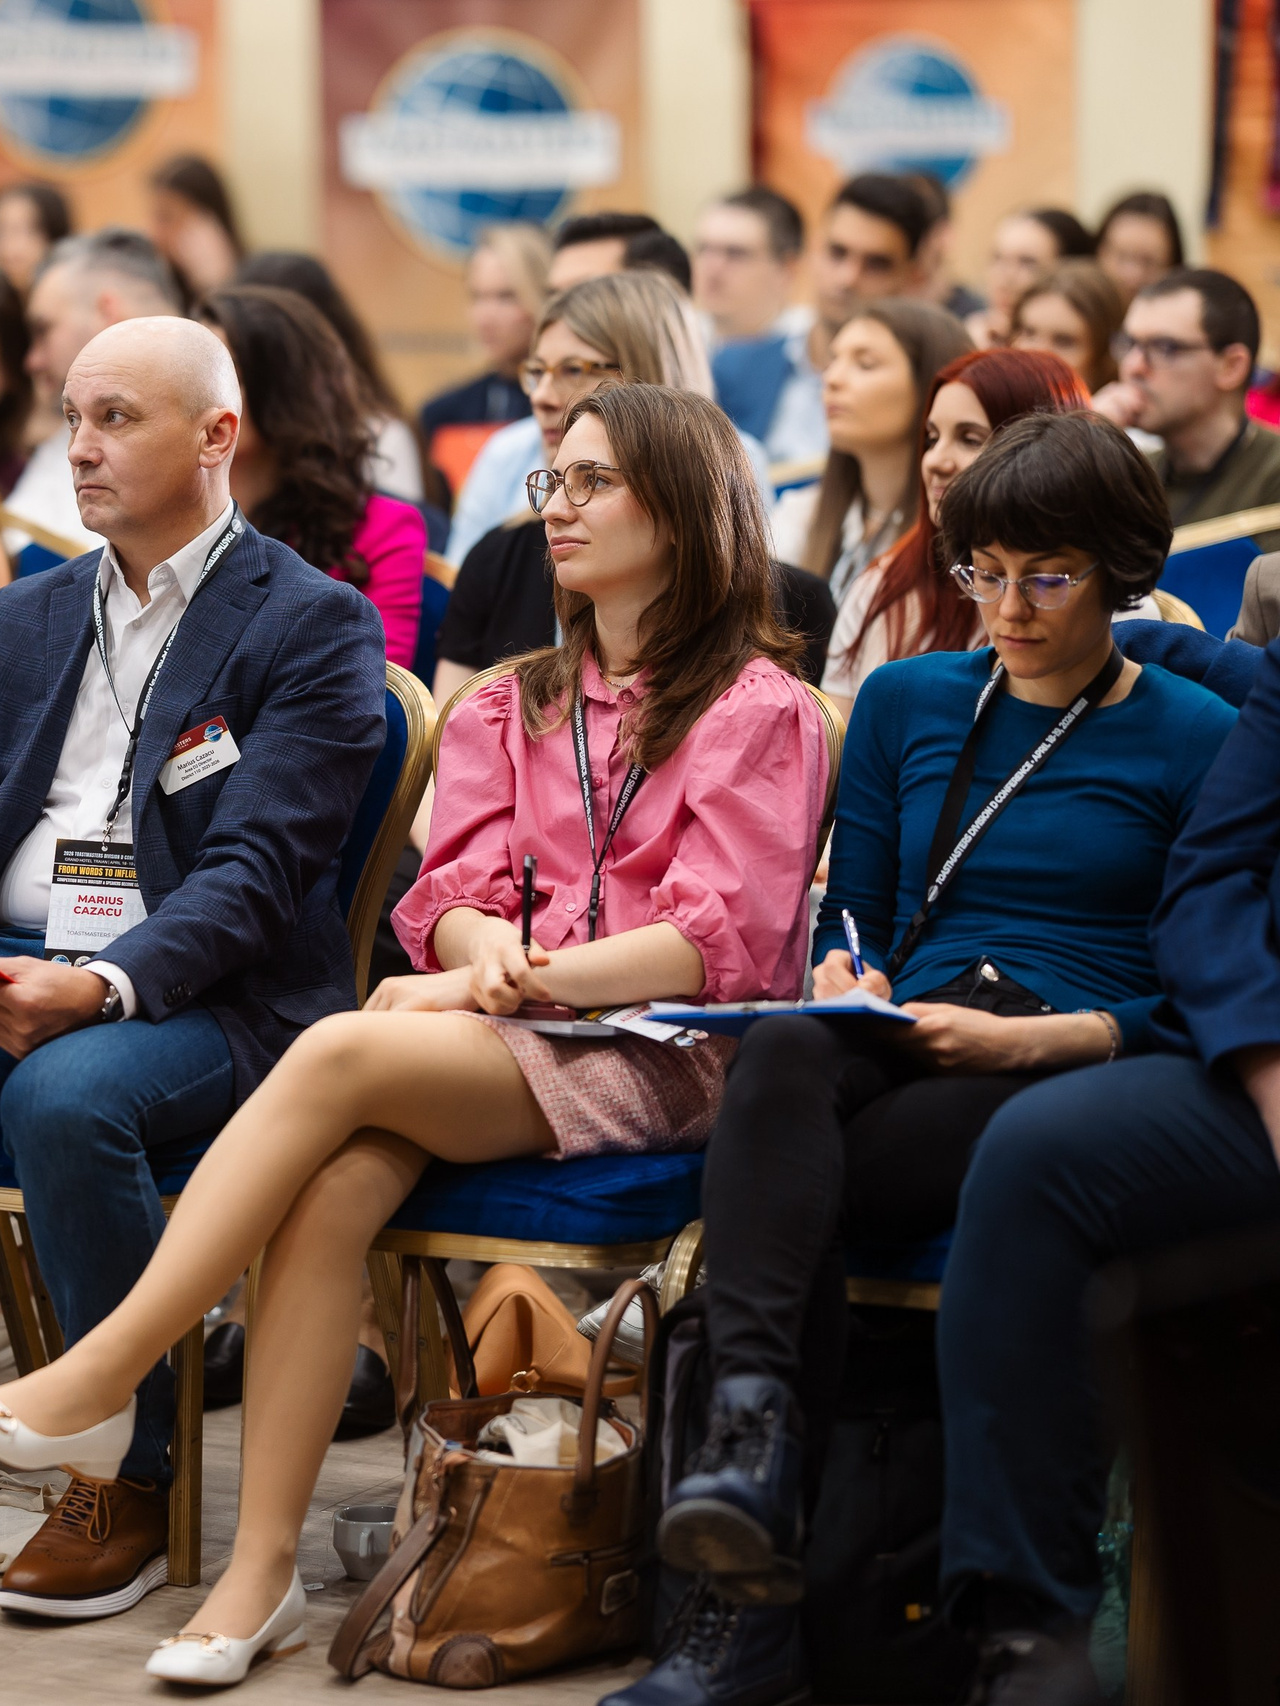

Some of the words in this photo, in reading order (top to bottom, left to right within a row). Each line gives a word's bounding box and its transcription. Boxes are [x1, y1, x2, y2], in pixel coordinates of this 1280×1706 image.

[204, 531, 235, 571] TOASTMASTERS
[177, 759, 196, 771] Marius
[195, 749, 215, 762] Cazacu
[576, 733, 588, 776] CONFERENCE
[198, 757, 213, 767] Director
[181, 771, 195, 781] District
[935, 832, 972, 885] TOASTMASTERS
[968, 803, 994, 838] DIVISION
[989, 797, 999, 810] D
[994, 760, 1034, 804] CONFERENCE
[1031, 742, 1051, 763] APRIL
[1059, 711, 1077, 730] 2026
[610, 778, 636, 832] TOASTMASTERS
[58, 865, 78, 875] FROM
[79, 866, 103, 876] WORDS
[104, 868, 113, 877] TO
[77, 894, 124, 906] MARIUS
[73, 905, 122, 917] CAZACU
[66, 930, 111, 938] TOASTMASTERS
